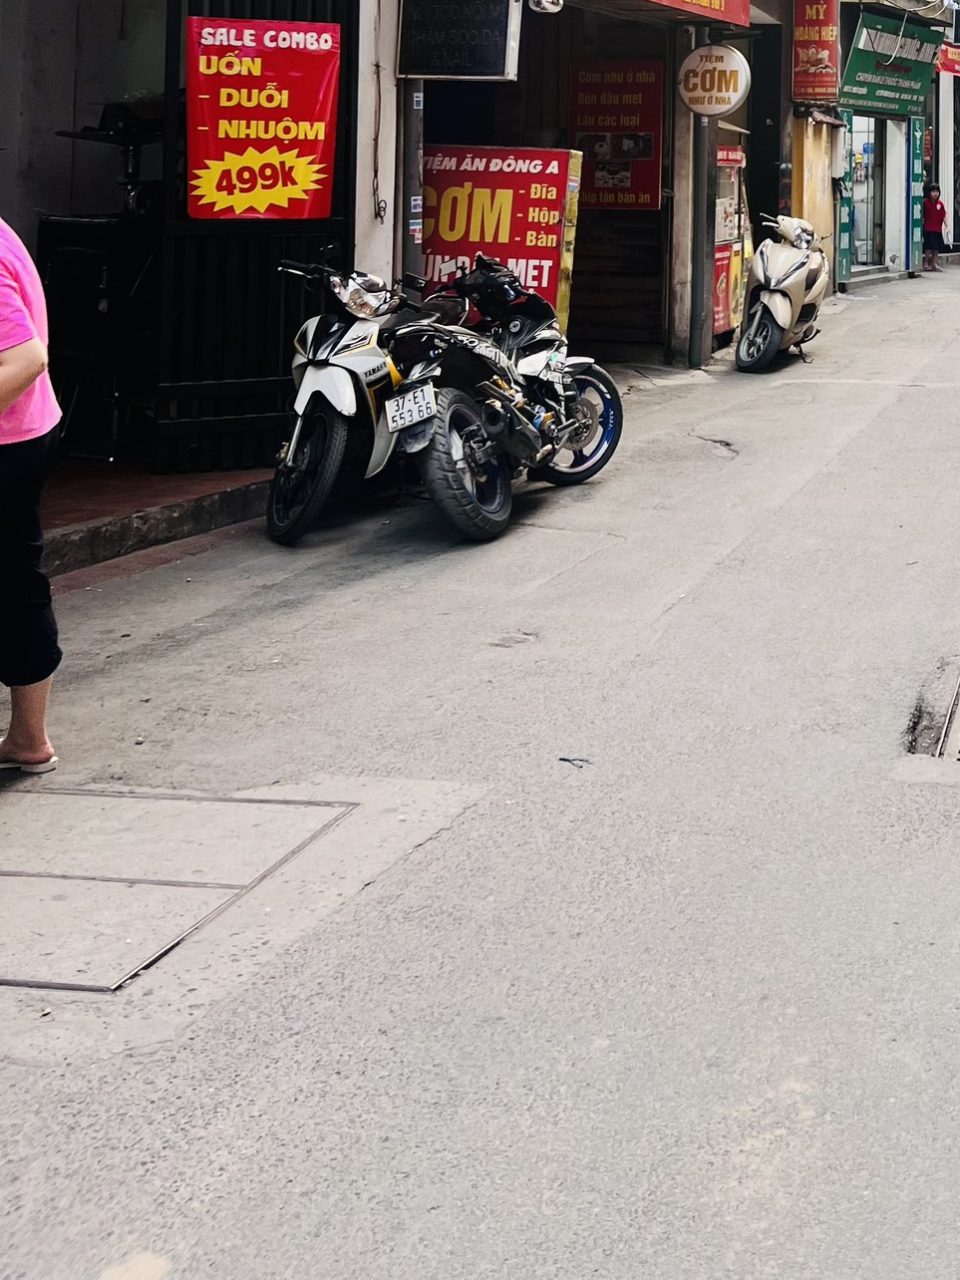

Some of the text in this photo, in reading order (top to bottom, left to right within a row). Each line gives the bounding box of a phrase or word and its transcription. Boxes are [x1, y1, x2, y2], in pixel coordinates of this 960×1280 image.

[805, 0, 827, 20] MỲ
[200, 27, 333, 50] SALE COMBO
[199, 50, 262, 77] UỐN
[699, 54, 724, 65] TIỆM
[683, 66, 739, 94] CƠM
[219, 82, 289, 109] DUỖI
[218, 117, 326, 144] NHUỘM
[460, 153, 487, 172] ĂN
[489, 155, 543, 173] ĐÔNG
[215, 160, 298, 196] 499k
[530, 183, 557, 200] Đĩa
[528, 207, 560, 227] Hộp
[526, 231, 557, 248] Bàn
